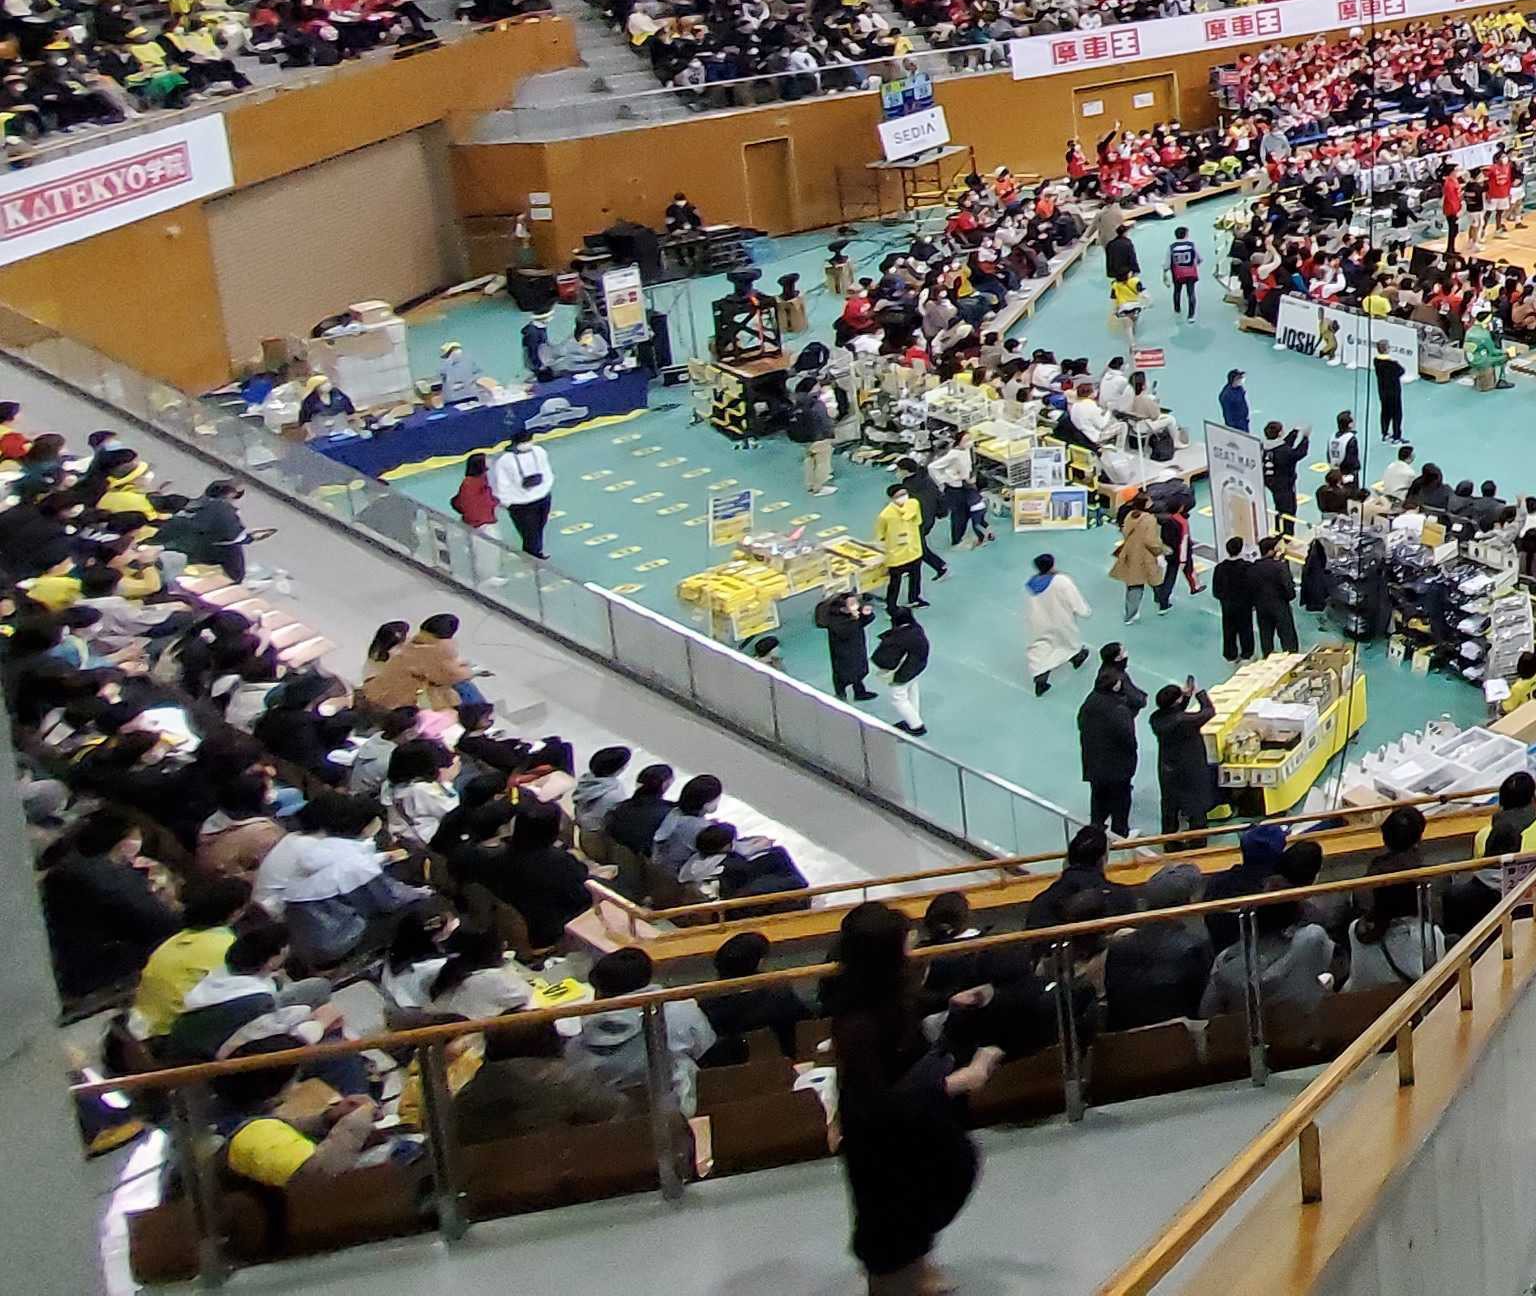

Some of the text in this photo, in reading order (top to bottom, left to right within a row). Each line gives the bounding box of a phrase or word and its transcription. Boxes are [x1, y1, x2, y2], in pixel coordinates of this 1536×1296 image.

[894, 121, 936, 145] SEDIA
[1277, 326, 1317, 356] JOSH
[1213, 445, 1236, 464] SEAT
